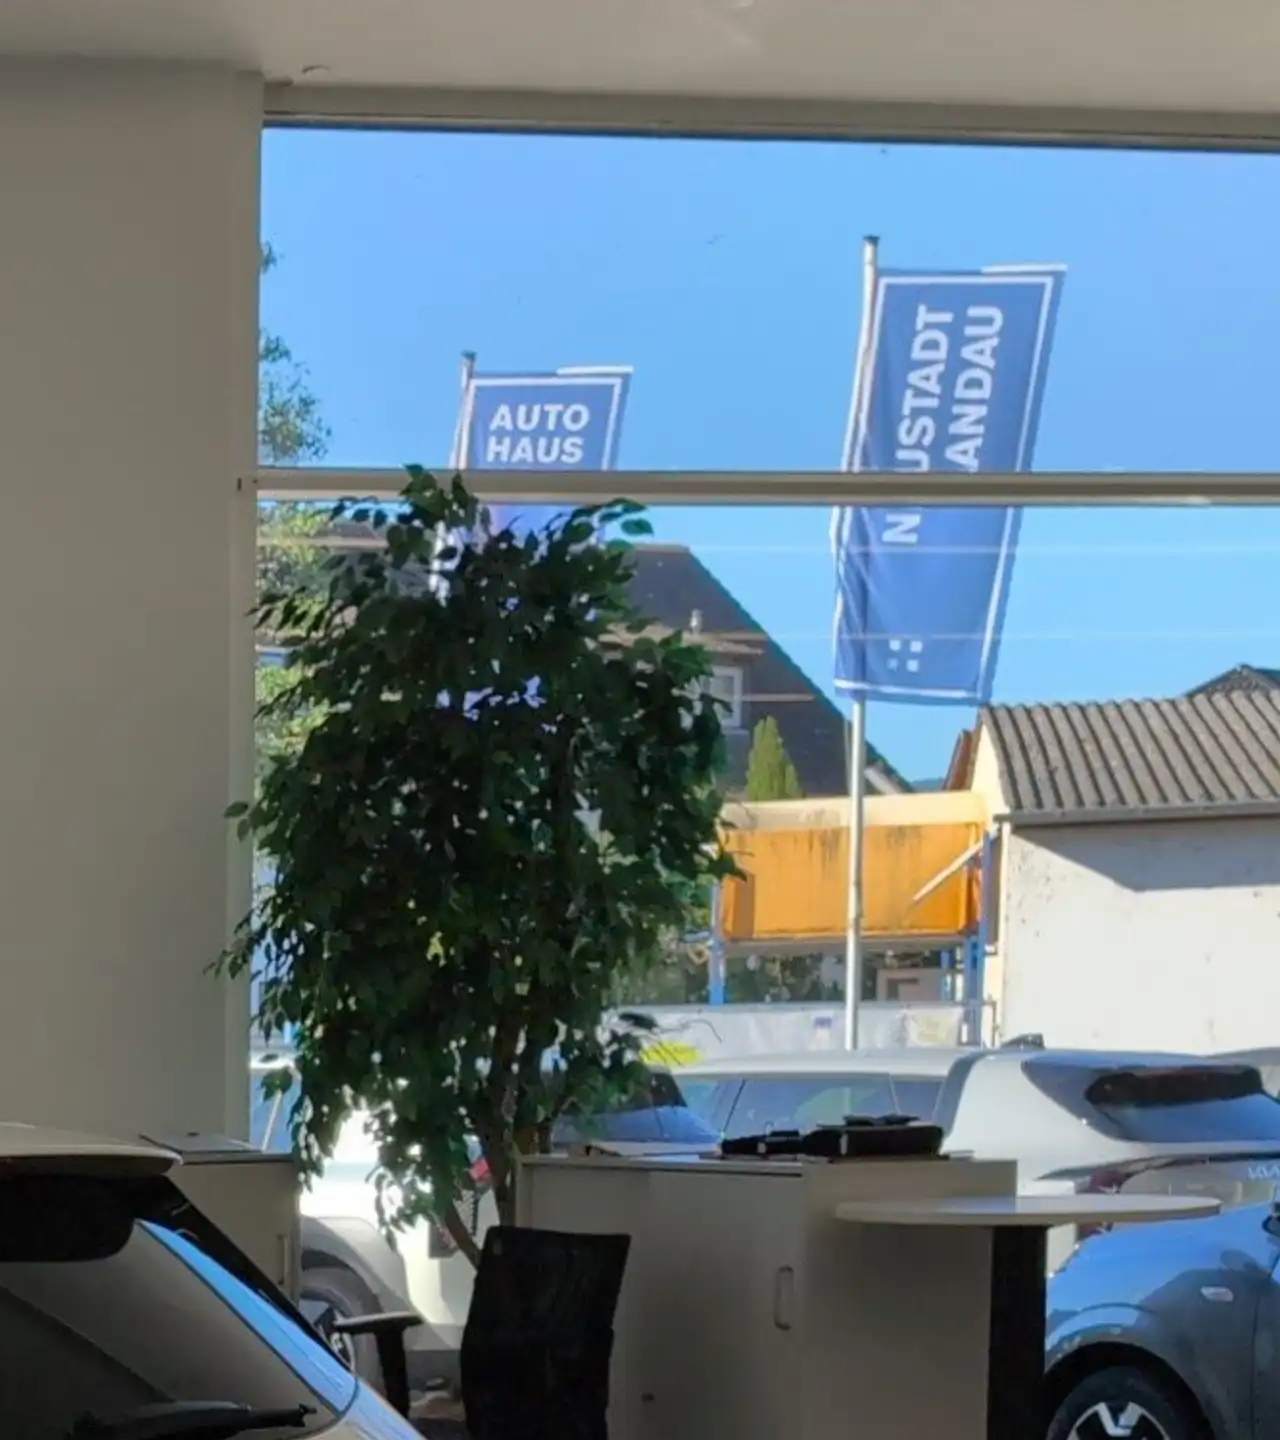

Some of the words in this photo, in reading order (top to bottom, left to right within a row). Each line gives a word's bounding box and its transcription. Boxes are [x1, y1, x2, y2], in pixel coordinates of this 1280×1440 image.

[488, 403, 590, 432] AUTO
[881, 304, 955, 544] NUSTADT
[943, 305, 1004, 473] ANDAU
[486, 435, 586, 464] HAUS
